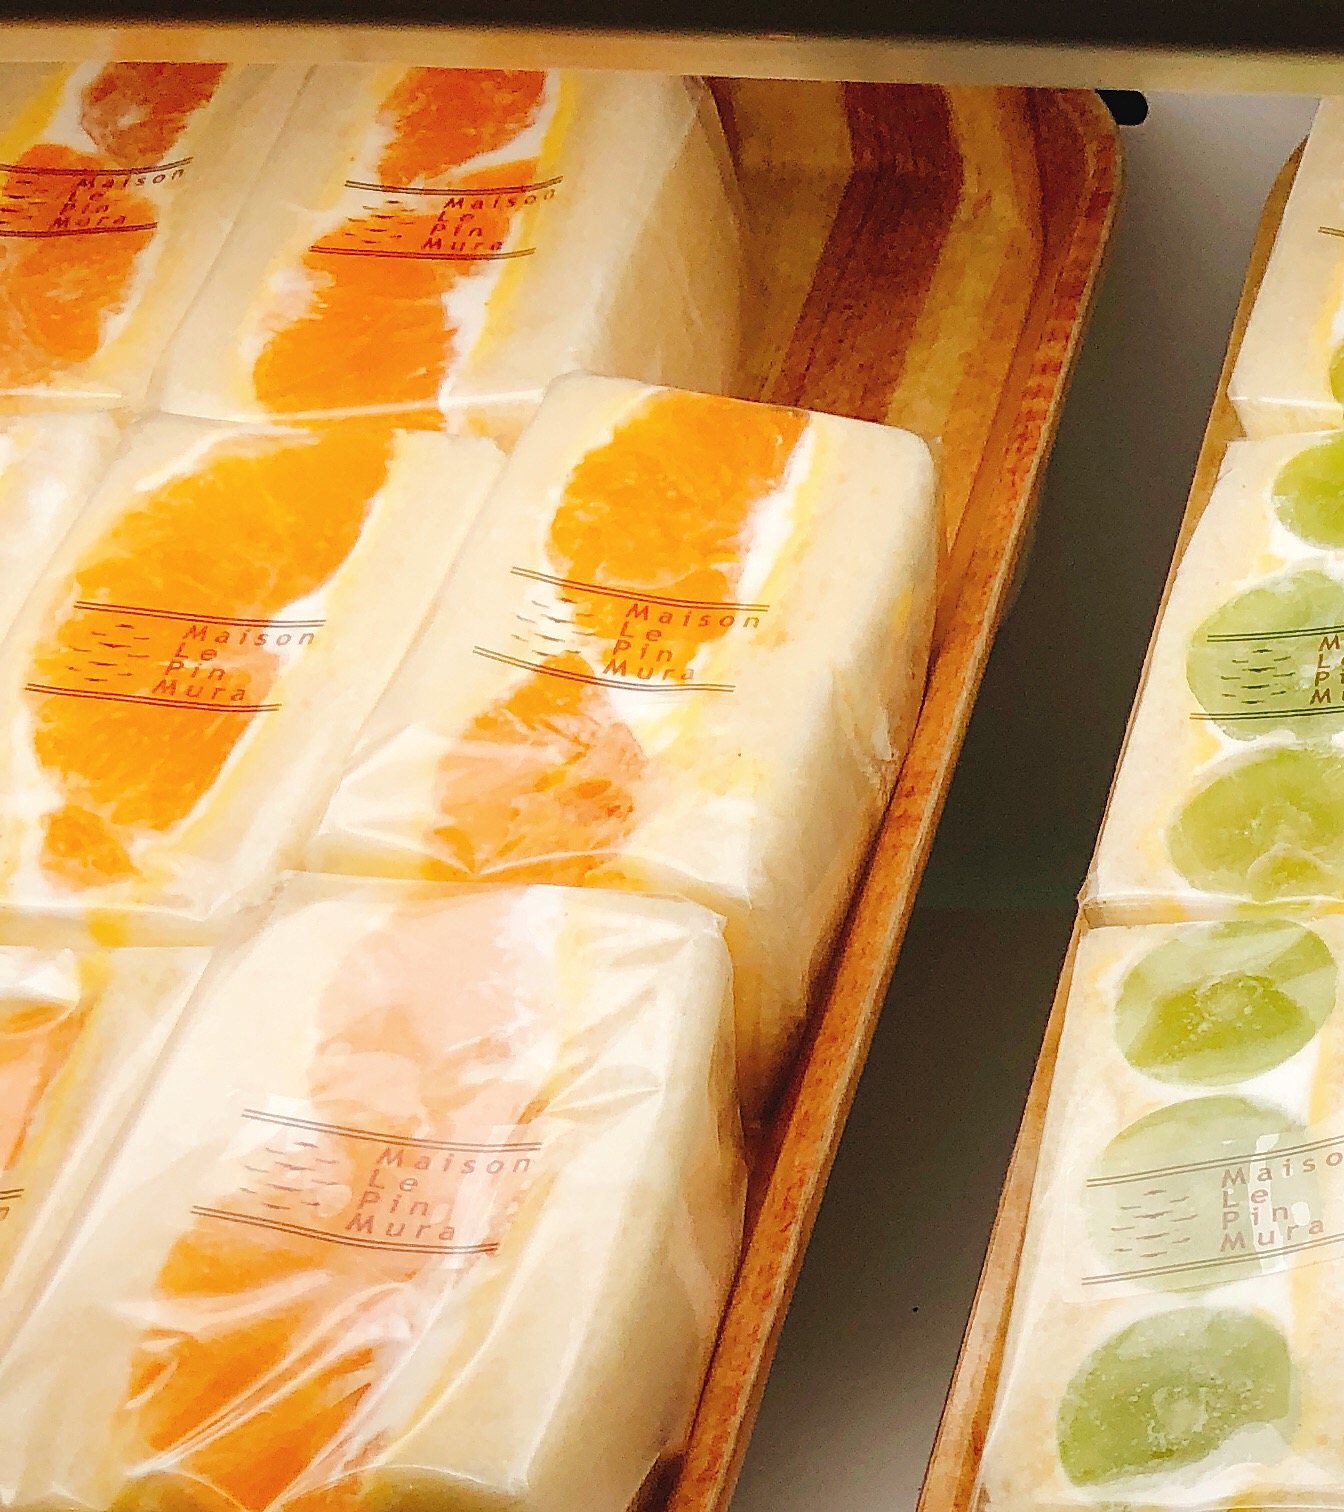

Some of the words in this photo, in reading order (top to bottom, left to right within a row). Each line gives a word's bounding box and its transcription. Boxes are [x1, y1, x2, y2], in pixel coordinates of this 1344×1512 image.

[77, 167, 185, 189] Maison
[66, 190, 105, 203] Le
[443, 187, 557, 210] Maison
[59, 201, 109, 216] Pin
[437, 210, 474, 223] Le
[52, 214, 128, 228] Mura
[428, 221, 483, 238] Pin
[421, 237, 504, 252] Mura
[625, 602, 761, 630] Maison
[181, 624, 315, 647] Maison
[619, 621, 663, 642] Le
[174, 641, 219, 661] Le
[611, 638, 674, 663] Pin
[164, 659, 227, 682] Pin
[601, 658, 696, 682] Mura
[151, 678, 246, 702] Mura
[376, 1146, 532, 1175] Maison
[367, 1169, 420, 1193] Le
[358, 1189, 430, 1217] Pin
[1221, 1187, 1270, 1209] Le
[344, 1212, 456, 1242] Mura
[1222, 1202, 1290, 1230] Pin
[1219, 1217, 1325, 1253] Mura
